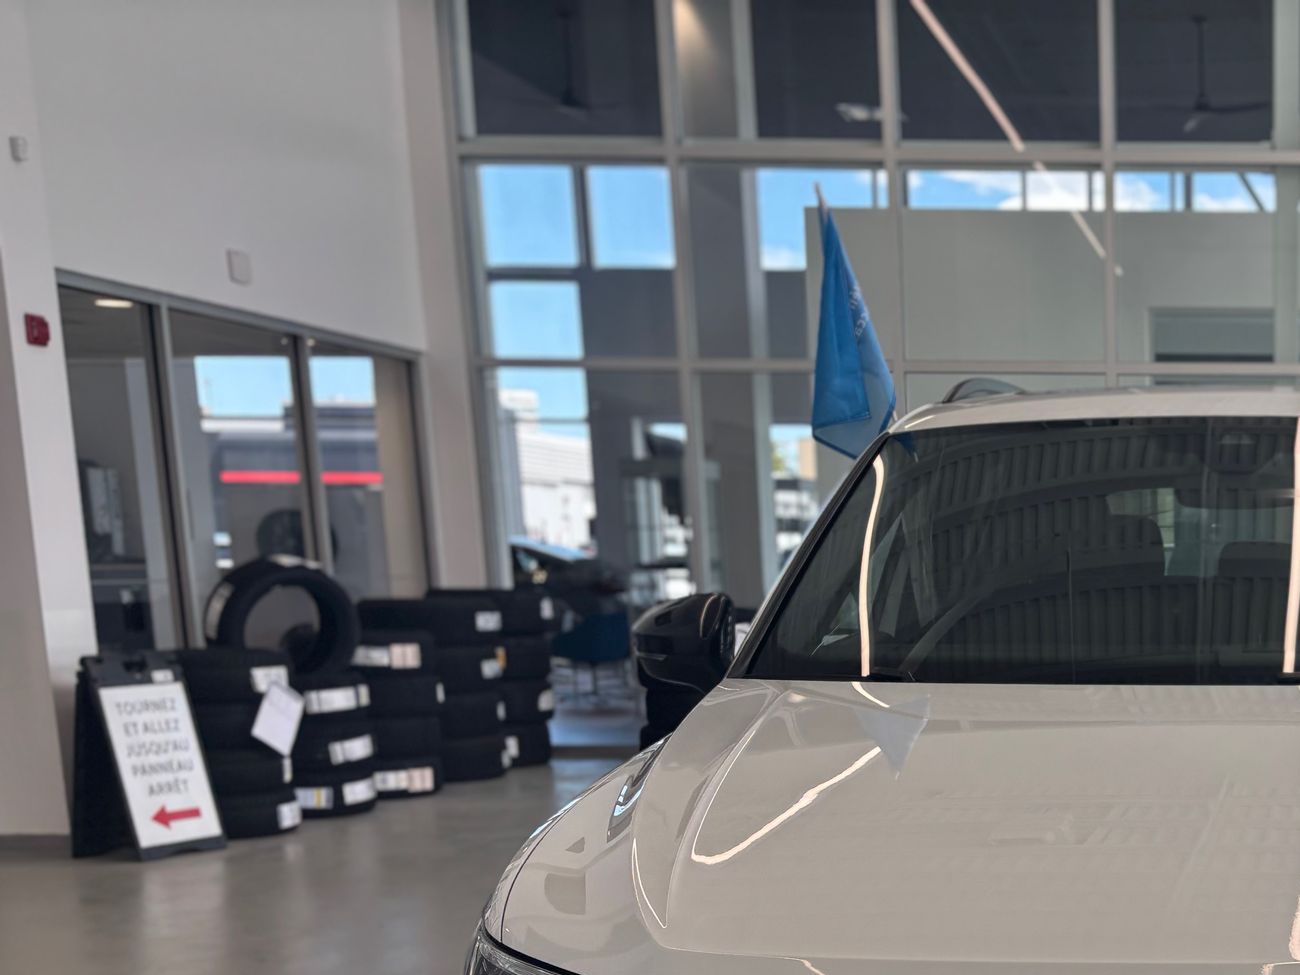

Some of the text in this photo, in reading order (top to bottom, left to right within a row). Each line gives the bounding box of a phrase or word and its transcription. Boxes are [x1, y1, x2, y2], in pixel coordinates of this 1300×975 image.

[115, 698, 176, 716] TOURNEZ
[123, 719, 181, 737] ET ALLEZ
[132, 759, 195, 777] PANNEAU
